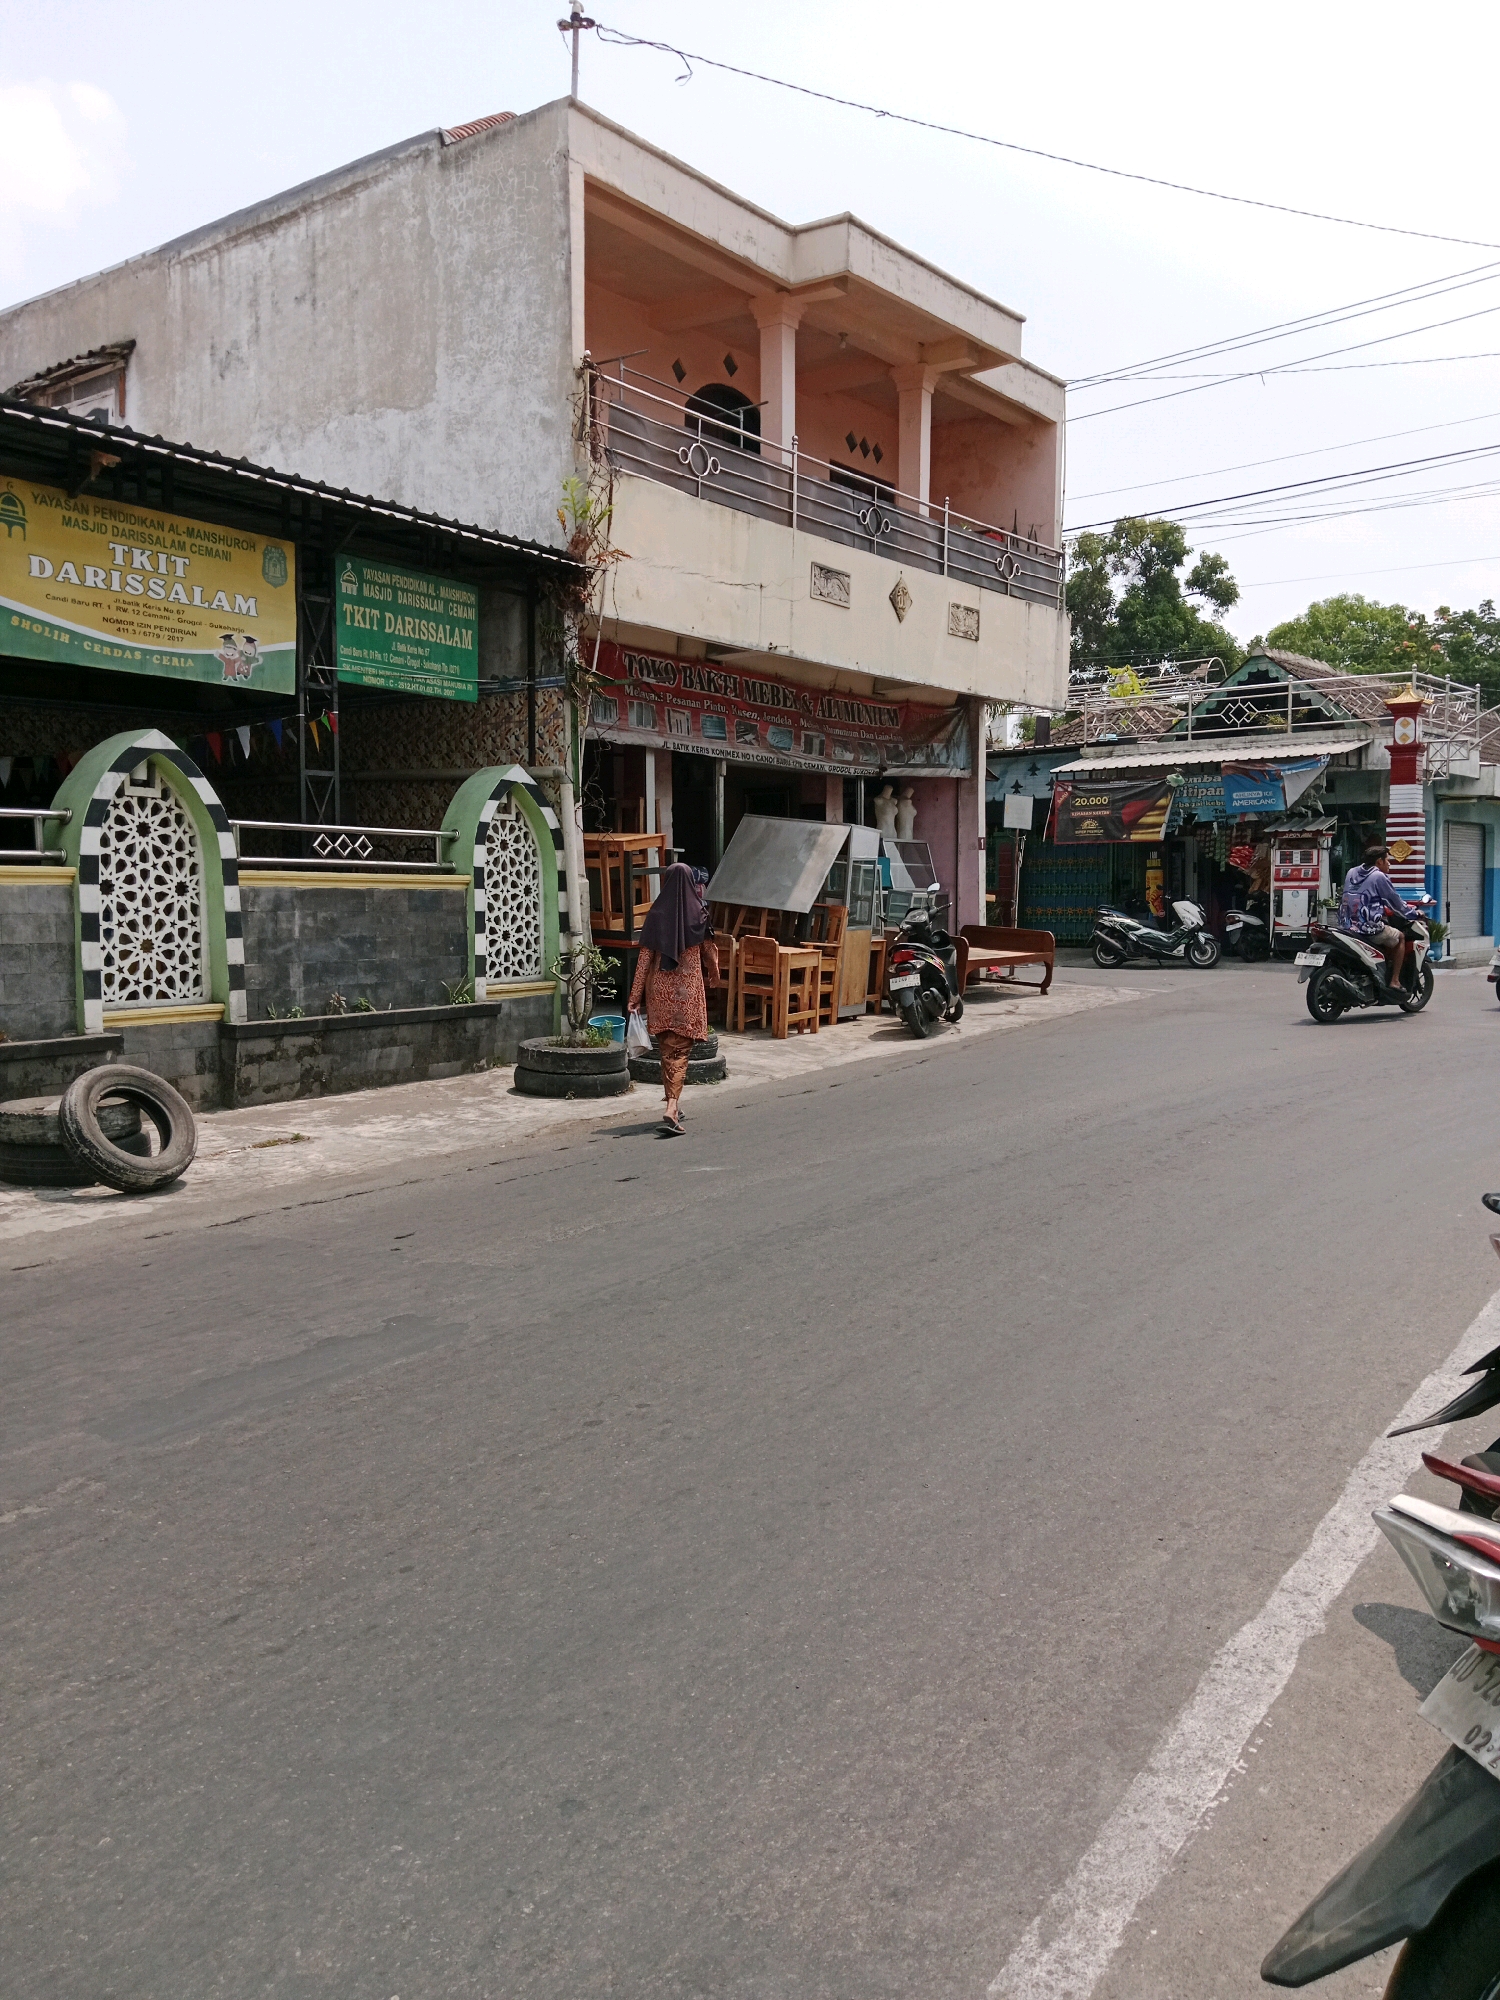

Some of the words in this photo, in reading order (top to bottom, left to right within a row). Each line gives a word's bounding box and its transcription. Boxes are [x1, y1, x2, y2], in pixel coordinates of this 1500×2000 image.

[31, 491, 90, 516] YAYASAN
[93, 505, 165, 532] PENDIDIKAN
[167, 521, 256, 552] AL-MANSHUROH
[61, 514, 108, 535] MASJID
[111, 525, 187, 552] DARISSALAM
[189, 543, 232, 562] CEMANI
[108, 541, 190, 578] TKIT
[28, 554, 258, 617] DARISSALAM
[362, 567, 391, 585] YAYASAN
[391, 574, 427, 593] PENDIDIKAN
[428, 583, 436, 596] AL
[45, 593, 69, 603] Candi
[71, 598, 90, 607] Baru
[142, 611, 171, 621] Cemani
[177, 617, 203, 628] Grogol
[363, 582, 393, 602] MASJID
[397, 590, 444, 614] DARISSALAM
[448, 602, 476, 620] CEMANI
[10, 615, 70, 644] SHOLIH
[83, 641, 142, 660] CERDAS
[152, 654, 195, 667] CERIA
[102, 616, 135, 627] NOMOR
[136, 622, 152, 630] IZIN
[153, 624, 198, 637] PENDIRIAN
[116, 627, 137, 636] 411.3
[143, 631, 161, 640] 6779
[167, 634, 184, 642] 2017
[343, 602, 380, 631] TKIT
[384, 612, 473, 650] DARISSALAM
[623, 651, 679, 688] TOKO
[666, 692, 702, 709] Pesanan
[762, 712, 792, 726] Jendela
[860, 729, 874, 740] Dan
[672, 741, 690, 752] BATIK
[691, 745, 710, 755] KERIS
[711, 748, 740, 759] KONIMEX
[1232, 798, 1277, 807] AMERICANO
[1449, 1646, 1486, 1683] AD
